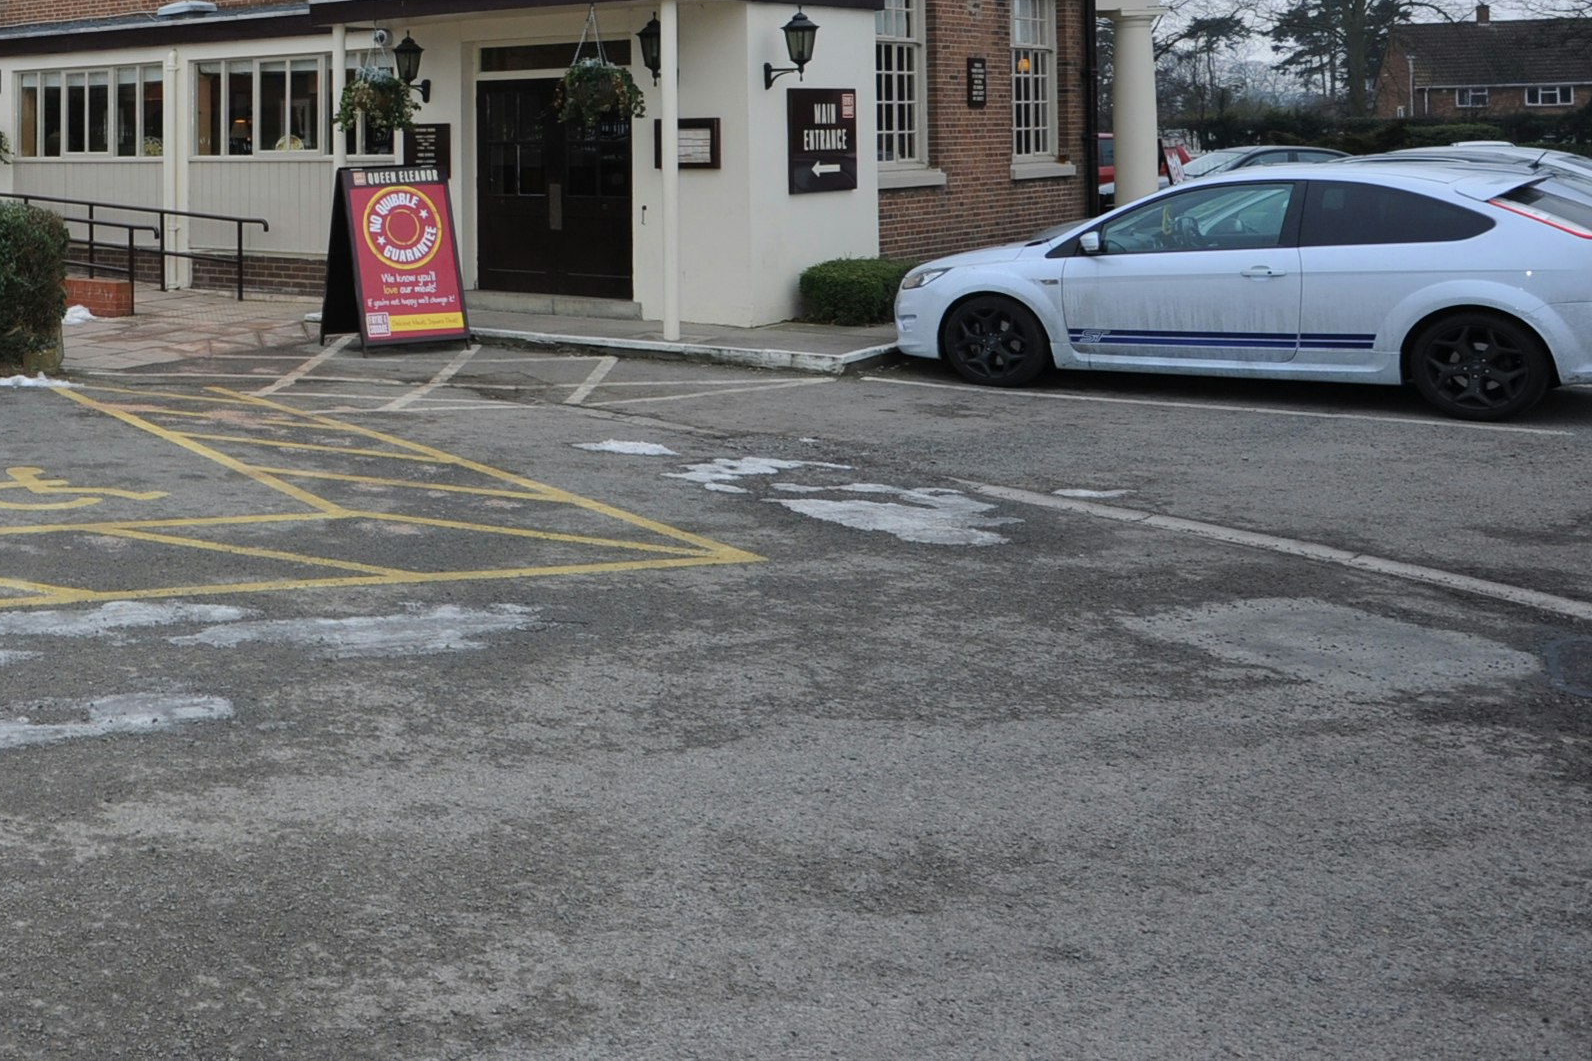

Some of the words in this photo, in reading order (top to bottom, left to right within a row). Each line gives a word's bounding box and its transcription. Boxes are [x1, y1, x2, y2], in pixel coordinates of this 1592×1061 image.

[814, 103, 836, 124] MAIN
[803, 128, 847, 151] ENTRANCE
[368, 171, 396, 185] QUEEN
[398, 169, 439, 183] ELEANOR
[375, 192, 420, 216] QUIBBLE
[369, 214, 383, 233] NO
[383, 225, 437, 262] GUARANTEE
[381, 273, 395, 284] We
[395, 273, 416, 283] know
[383, 285, 399, 295] love
[399, 286, 412, 294] our
